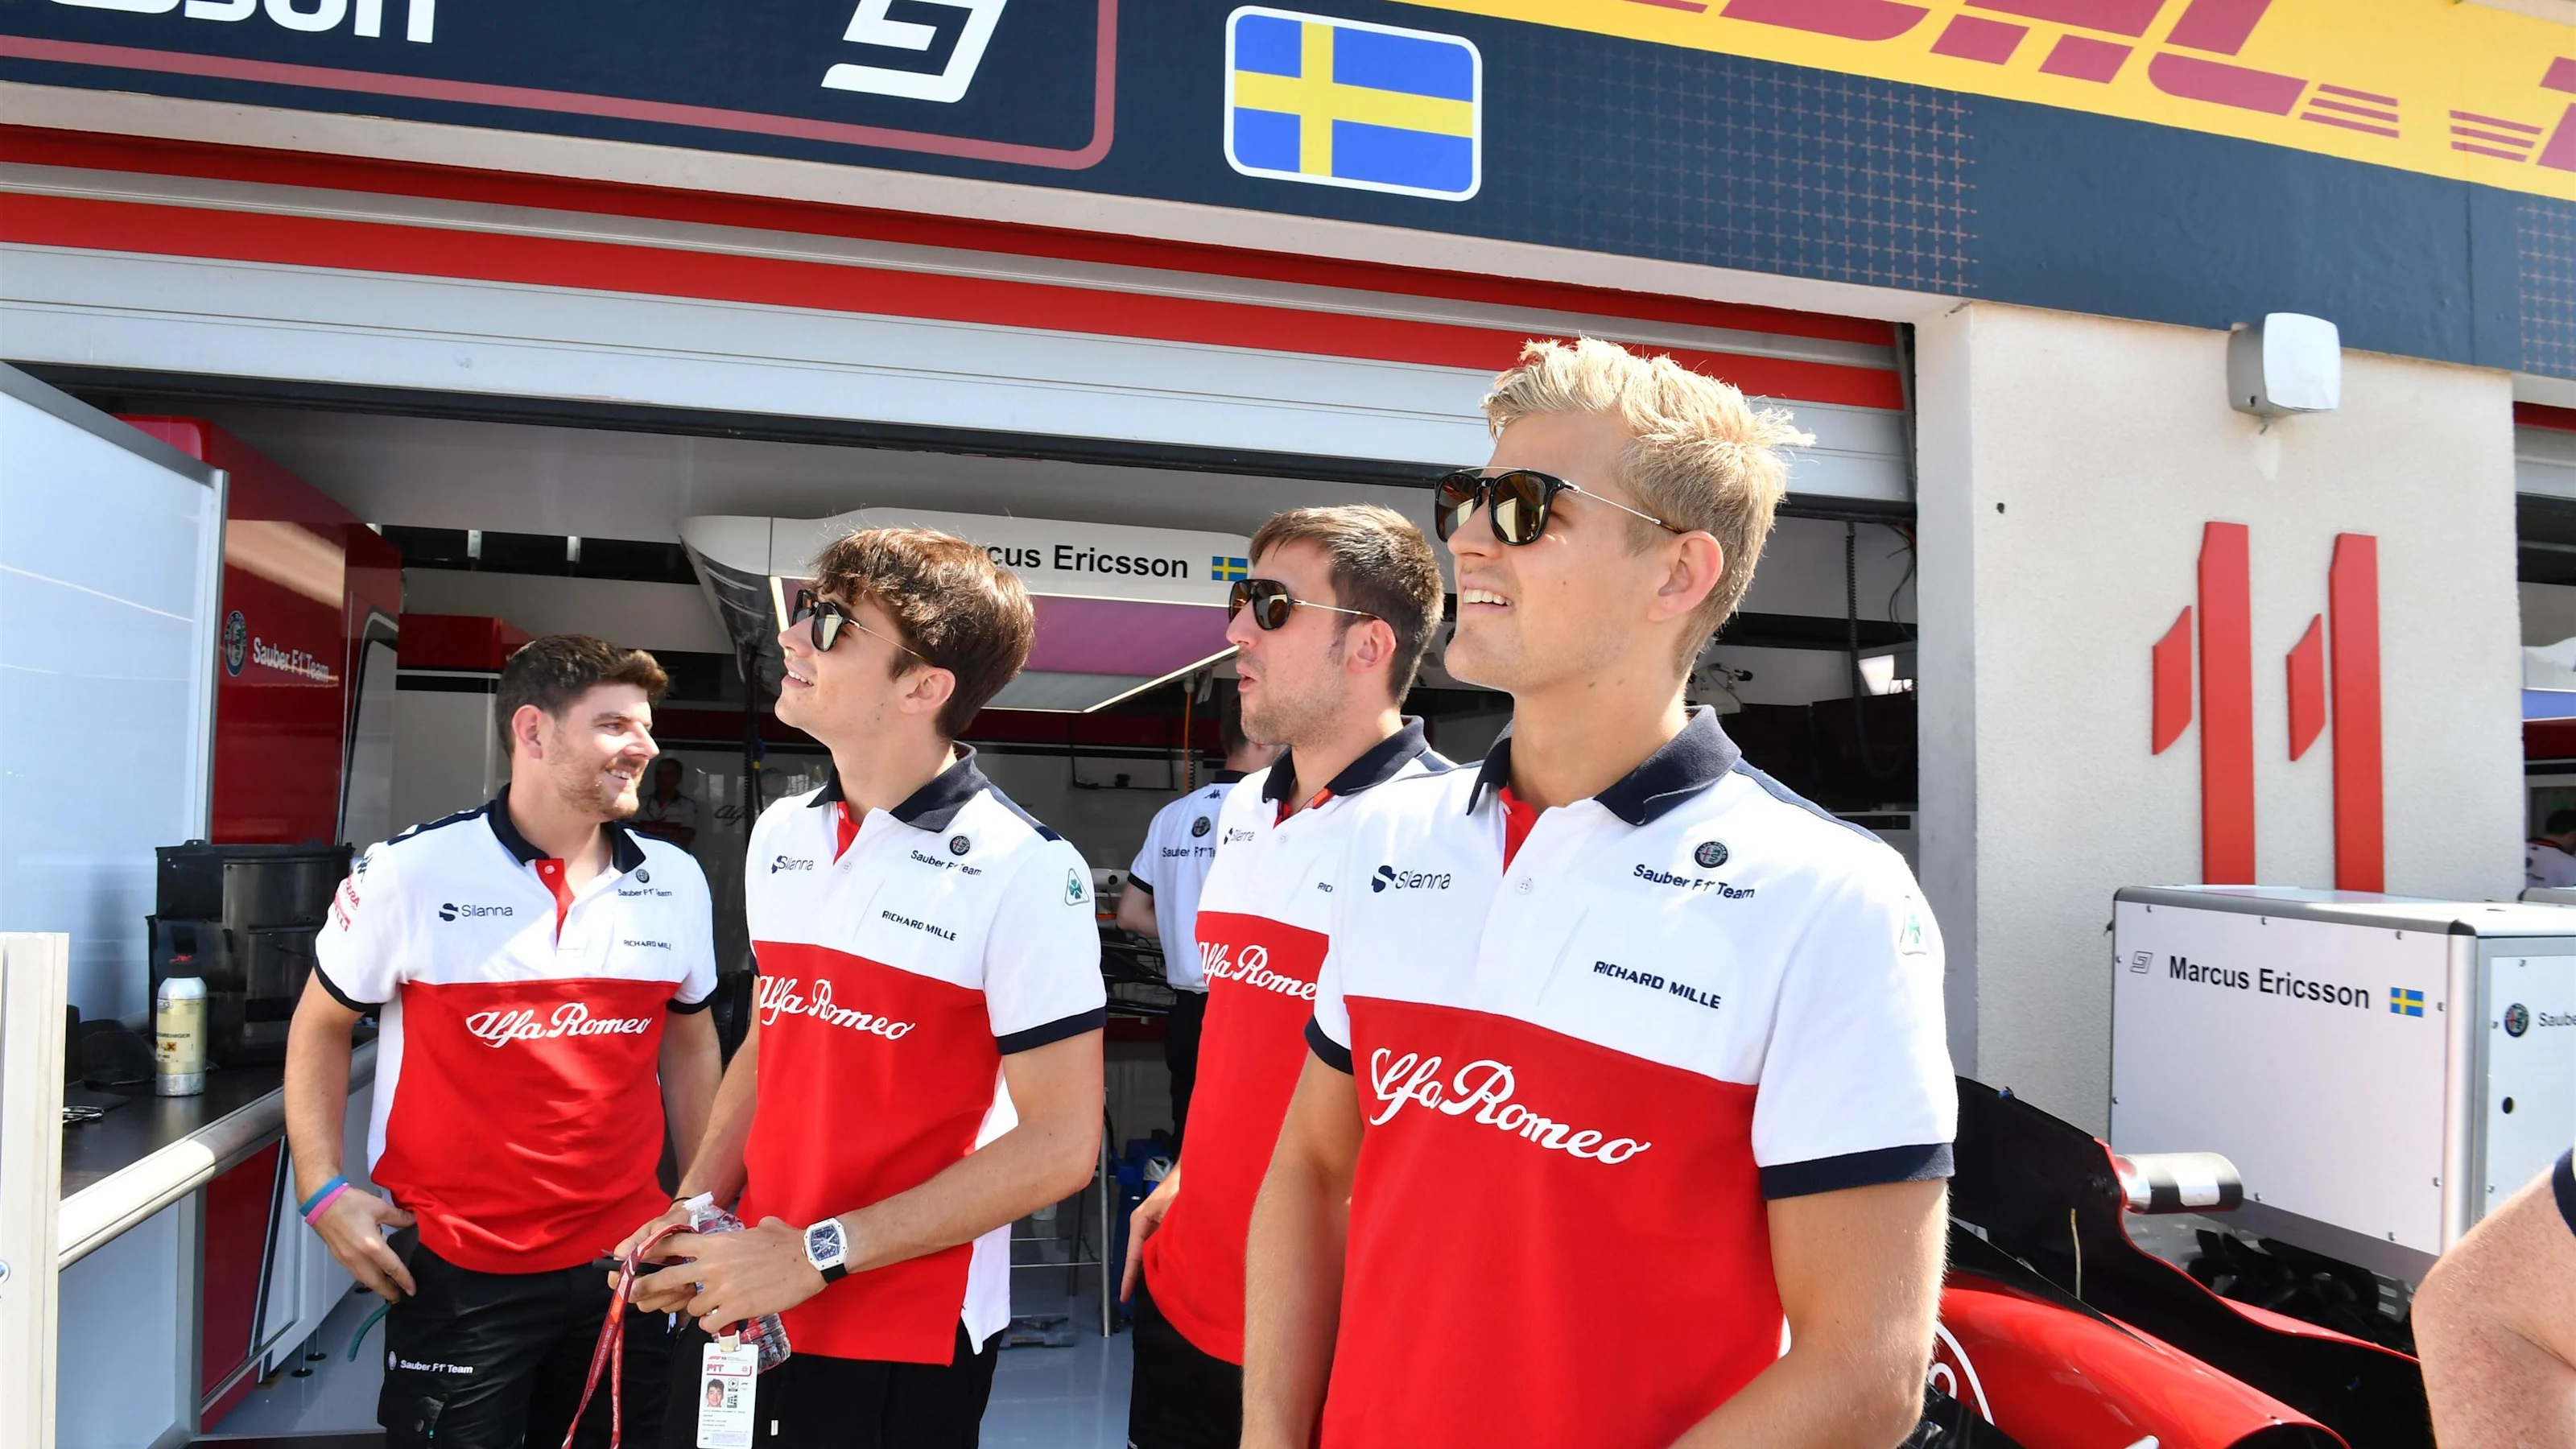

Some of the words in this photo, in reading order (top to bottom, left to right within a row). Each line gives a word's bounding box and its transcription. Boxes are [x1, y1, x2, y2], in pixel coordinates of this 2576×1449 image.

[987, 545, 1042, 568] cus
[1054, 544, 1188, 579] Ericsson
[253, 637, 290, 671] Sauber
[306, 654, 329, 683] Team
[910, 849, 945, 868] Sauber
[1633, 864, 1690, 887] Sauber
[1717, 882, 1755, 899] Team
[461, 905, 513, 917] Silanna
[881, 910, 923, 930] RICHARD
[925, 924, 957, 941] MILLE
[624, 939, 656, 947] RICHARD
[1232, 944, 1317, 1001] Rome
[1593, 960, 1664, 989] RICHARD
[1669, 981, 1721, 1009] MILLE
[2170, 956, 2249, 989] Marcus
[2259, 968, 2370, 1009] Ericsson
[465, 1009, 547, 1048] Alfa
[546, 1002, 653, 1038] Romeo
[807, 978, 916, 1040] Romeo
[1439, 1059, 1652, 1164] Romeo
[400, 1360, 431, 1371] Sauber
[447, 1364, 473, 1374] Team
[707, 1364, 724, 1373] PIT
